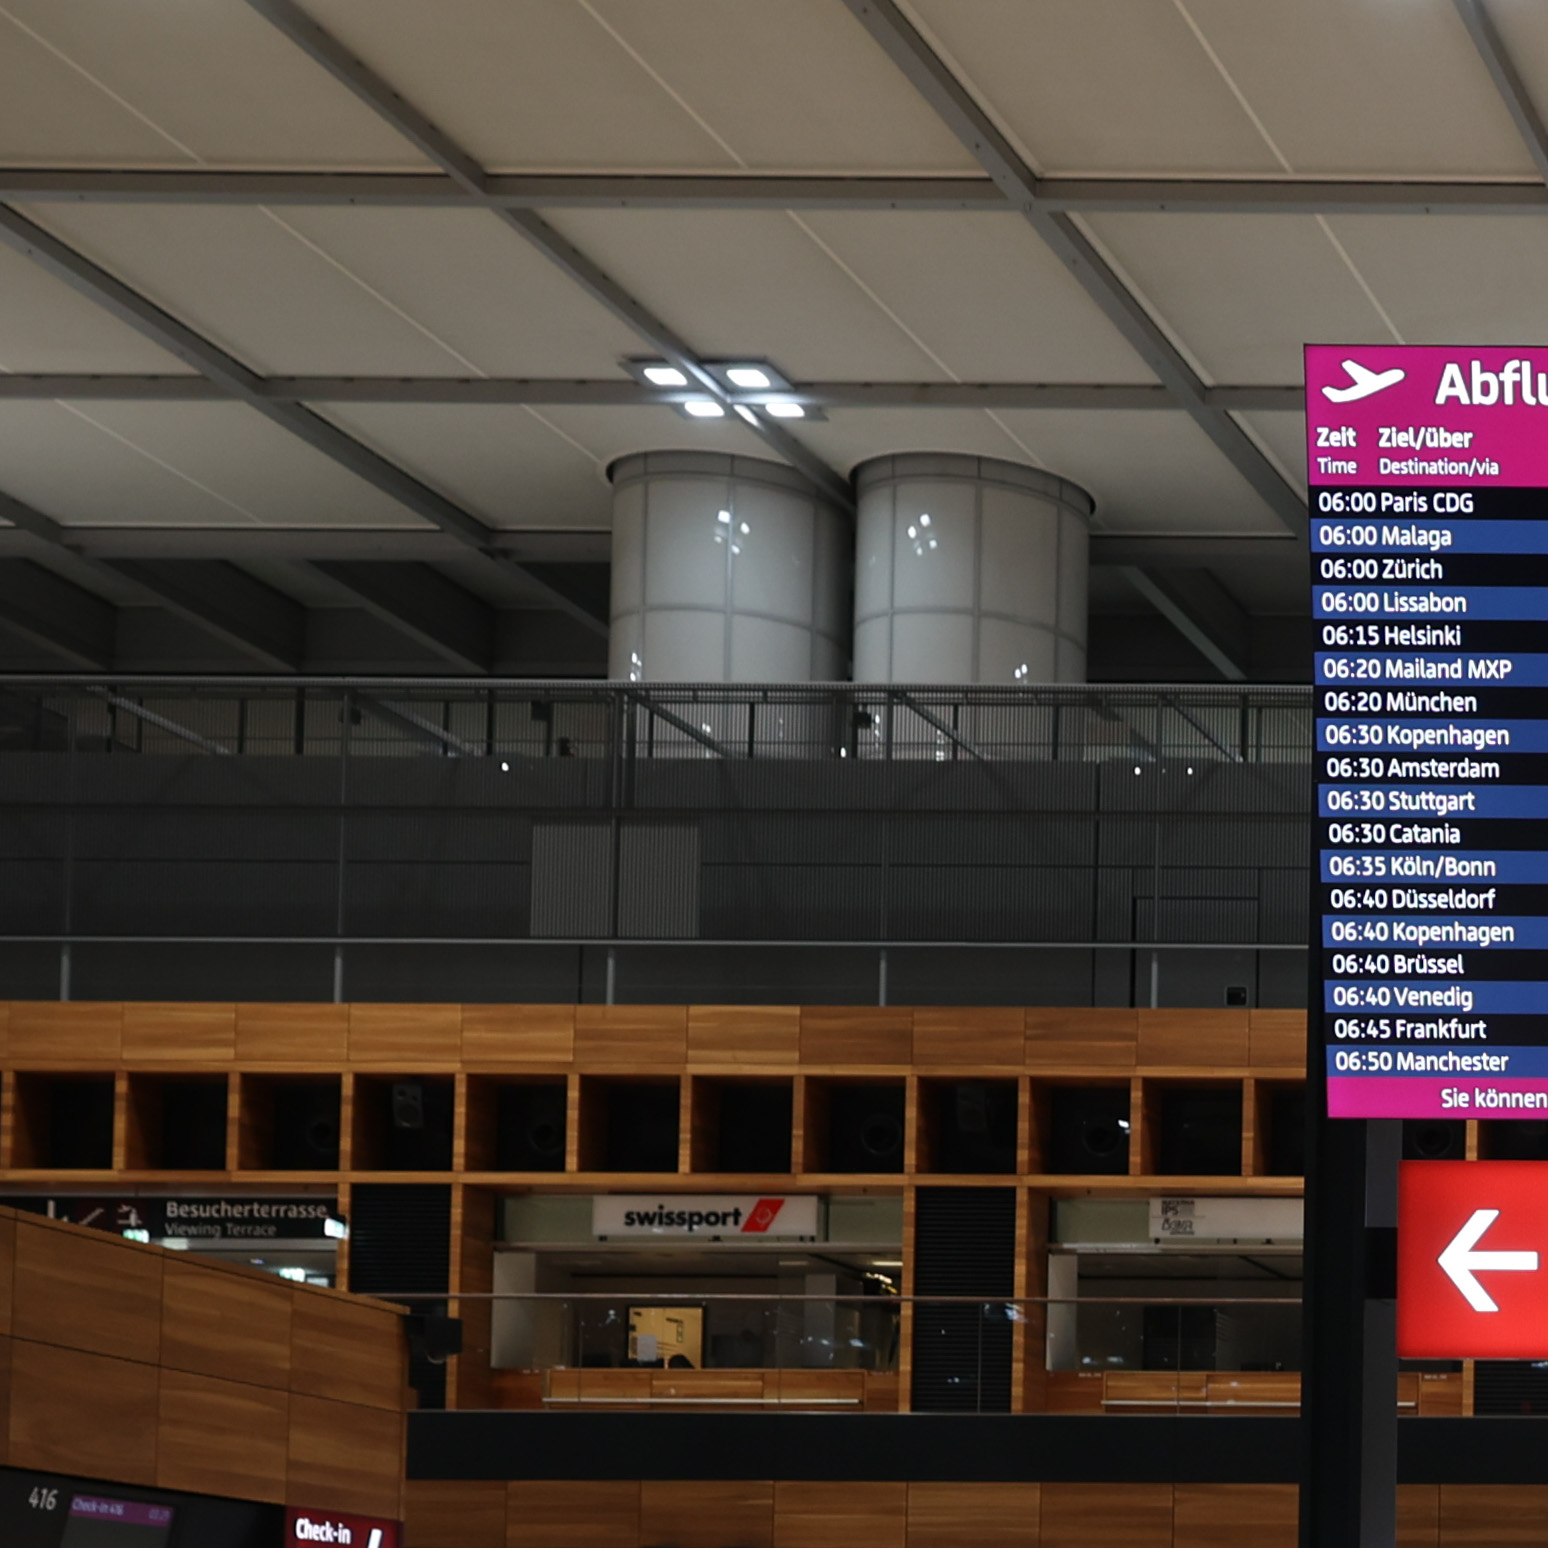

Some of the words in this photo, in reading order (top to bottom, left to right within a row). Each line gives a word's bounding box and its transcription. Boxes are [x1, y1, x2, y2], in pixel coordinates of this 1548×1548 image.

[1317, 426, 1356, 447] Zeit
[1379, 427, 1473, 450] Ziel/über
[1317, 457, 1357, 474] Time
[1380, 457, 1499, 477] Destination/via
[1319, 492, 1376, 512] 06:00
[1381, 491, 1428, 512] Paris
[1433, 493, 1473, 513] CDG
[1330, 856, 1386, 876] 06:35
[1391, 856, 1496, 878] Köln/Bonn
[1336, 1051, 1392, 1071] 06:50
[1397, 1051, 1509, 1071] Manchester
[1441, 1088, 1469, 1108] Sie
[1475, 1088, 1548, 1108] können
[166, 1201, 327, 1218] Besucherterrasse
[625, 1204, 742, 1232] swissport
[165, 1223, 221, 1238] Viewing
[226, 1223, 276, 1236] Terrace
[28, 1486, 58, 1510] 416
[295, 1517, 352, 1545] Check-in
